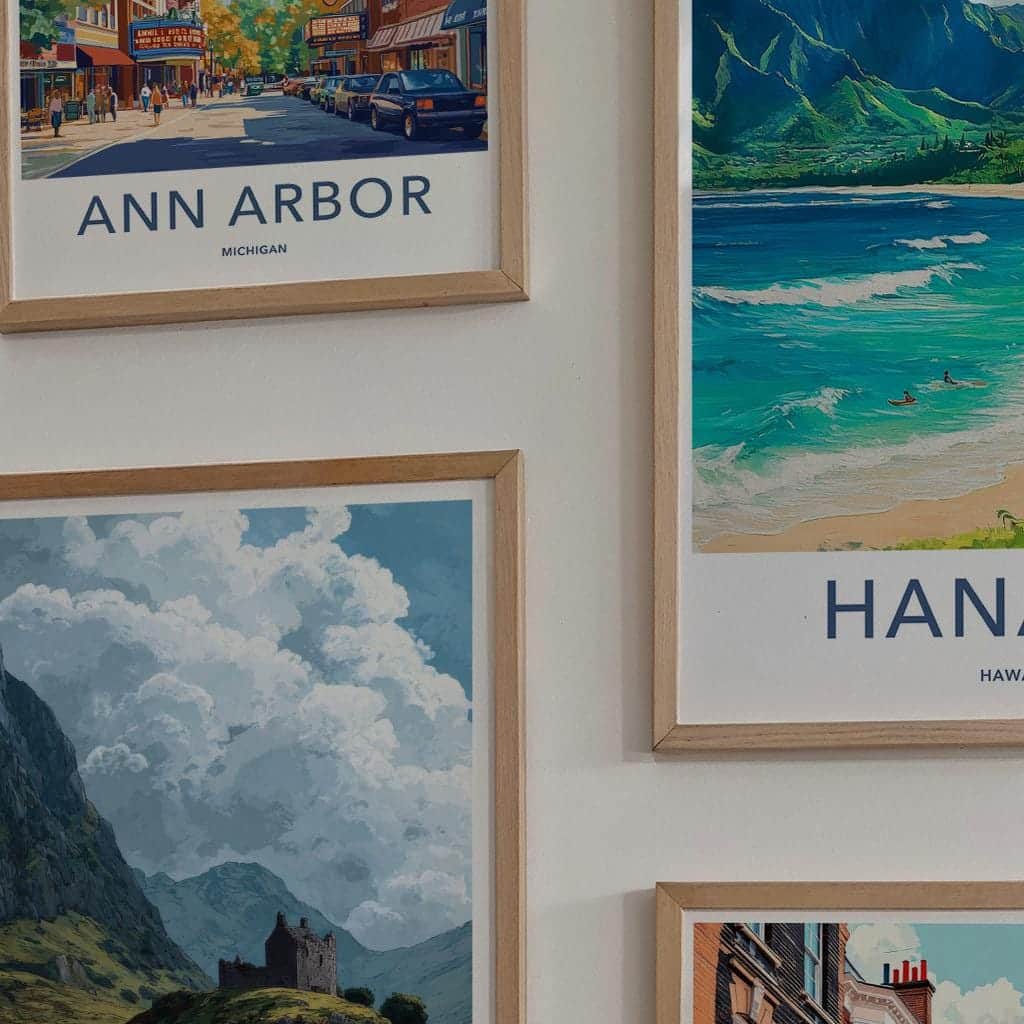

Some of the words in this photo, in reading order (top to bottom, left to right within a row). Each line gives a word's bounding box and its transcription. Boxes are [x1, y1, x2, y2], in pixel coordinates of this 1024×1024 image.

[76, 188, 204, 236] ANN
[228, 175, 432, 227] ARBOR
[221, 243, 288, 257] MICHIGAN
[826, 577, 1024, 640] HAN
[980, 668, 1024, 682] HAW
